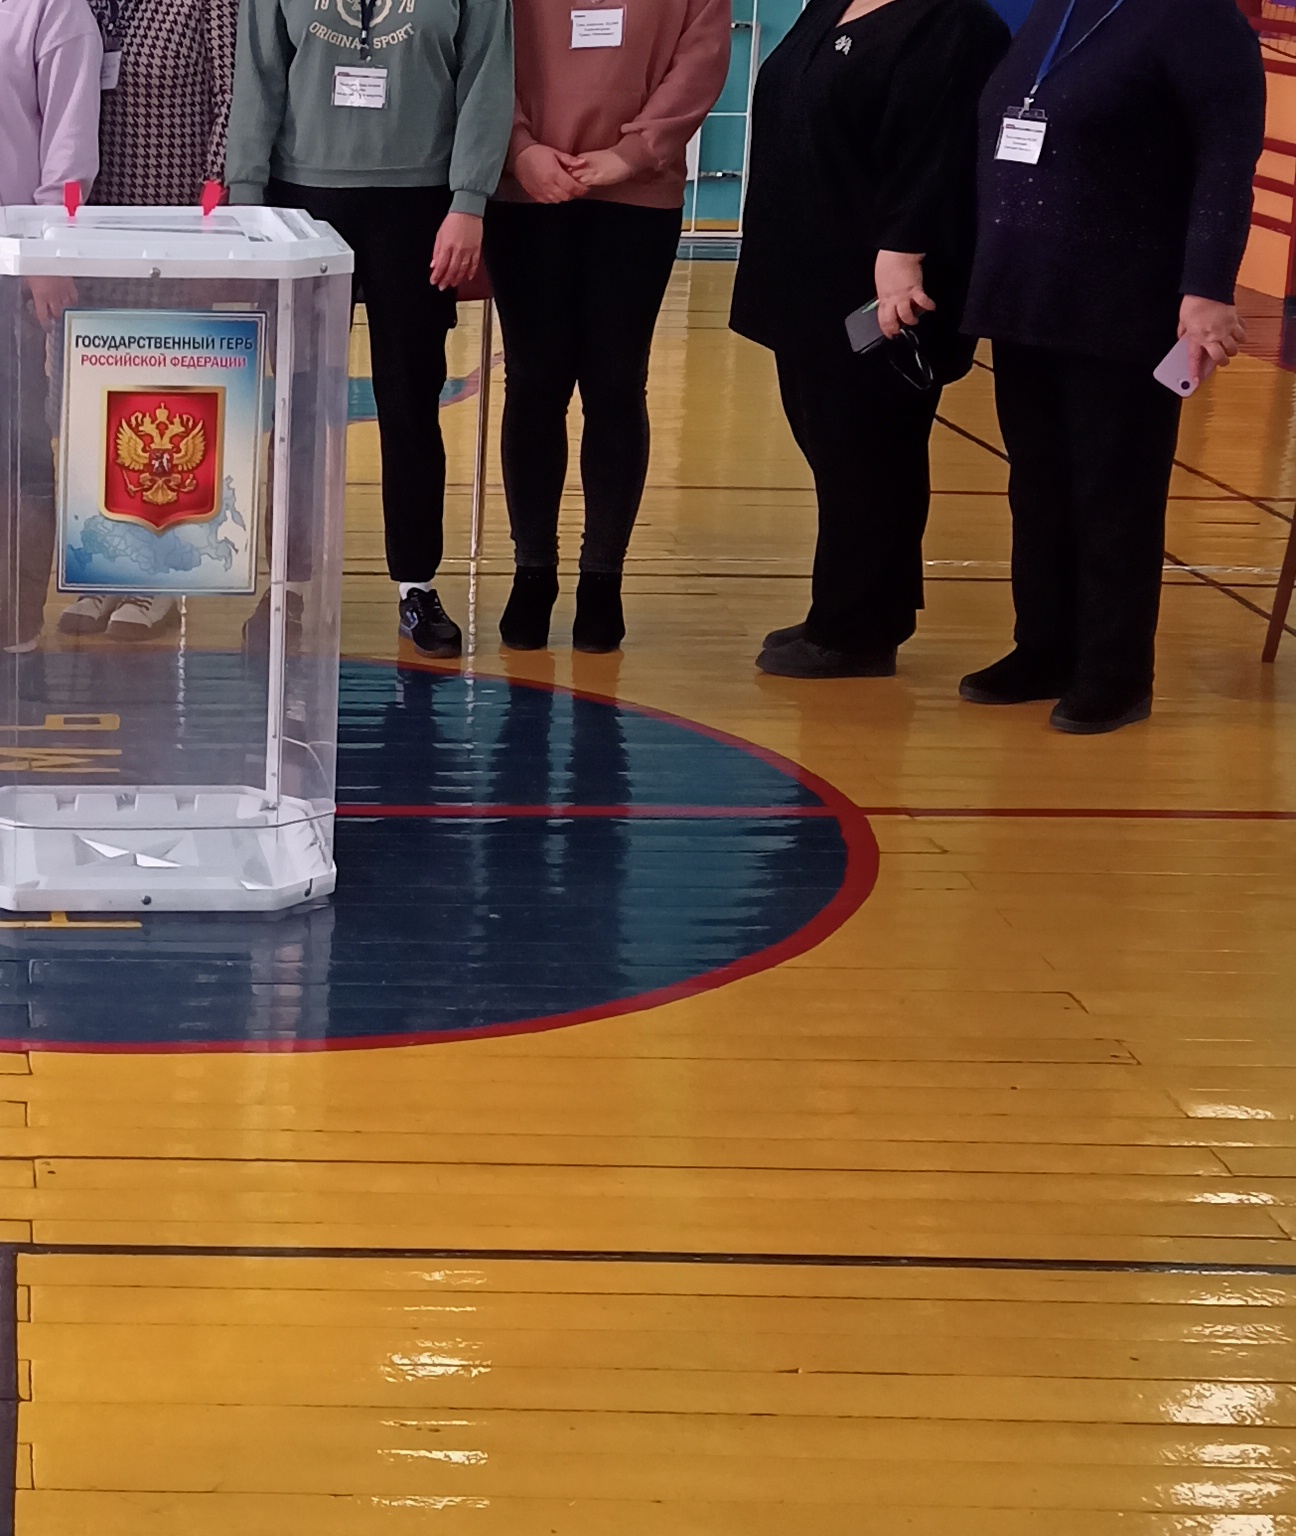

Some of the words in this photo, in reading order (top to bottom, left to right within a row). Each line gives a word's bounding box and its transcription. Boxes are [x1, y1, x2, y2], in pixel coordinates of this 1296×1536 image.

[309, 21, 368, 50] ORIGINA
[373, 22, 415, 49] SPORT
[75, 334, 215, 351] ГОСУДАРСТВЕННЫЙ
[219, 336, 253, 350] ГЕРБ
[81, 352, 167, 368] РОССИЙСКОЙ
[170, 355, 246, 369] ФЕДЕРАЦИИ
